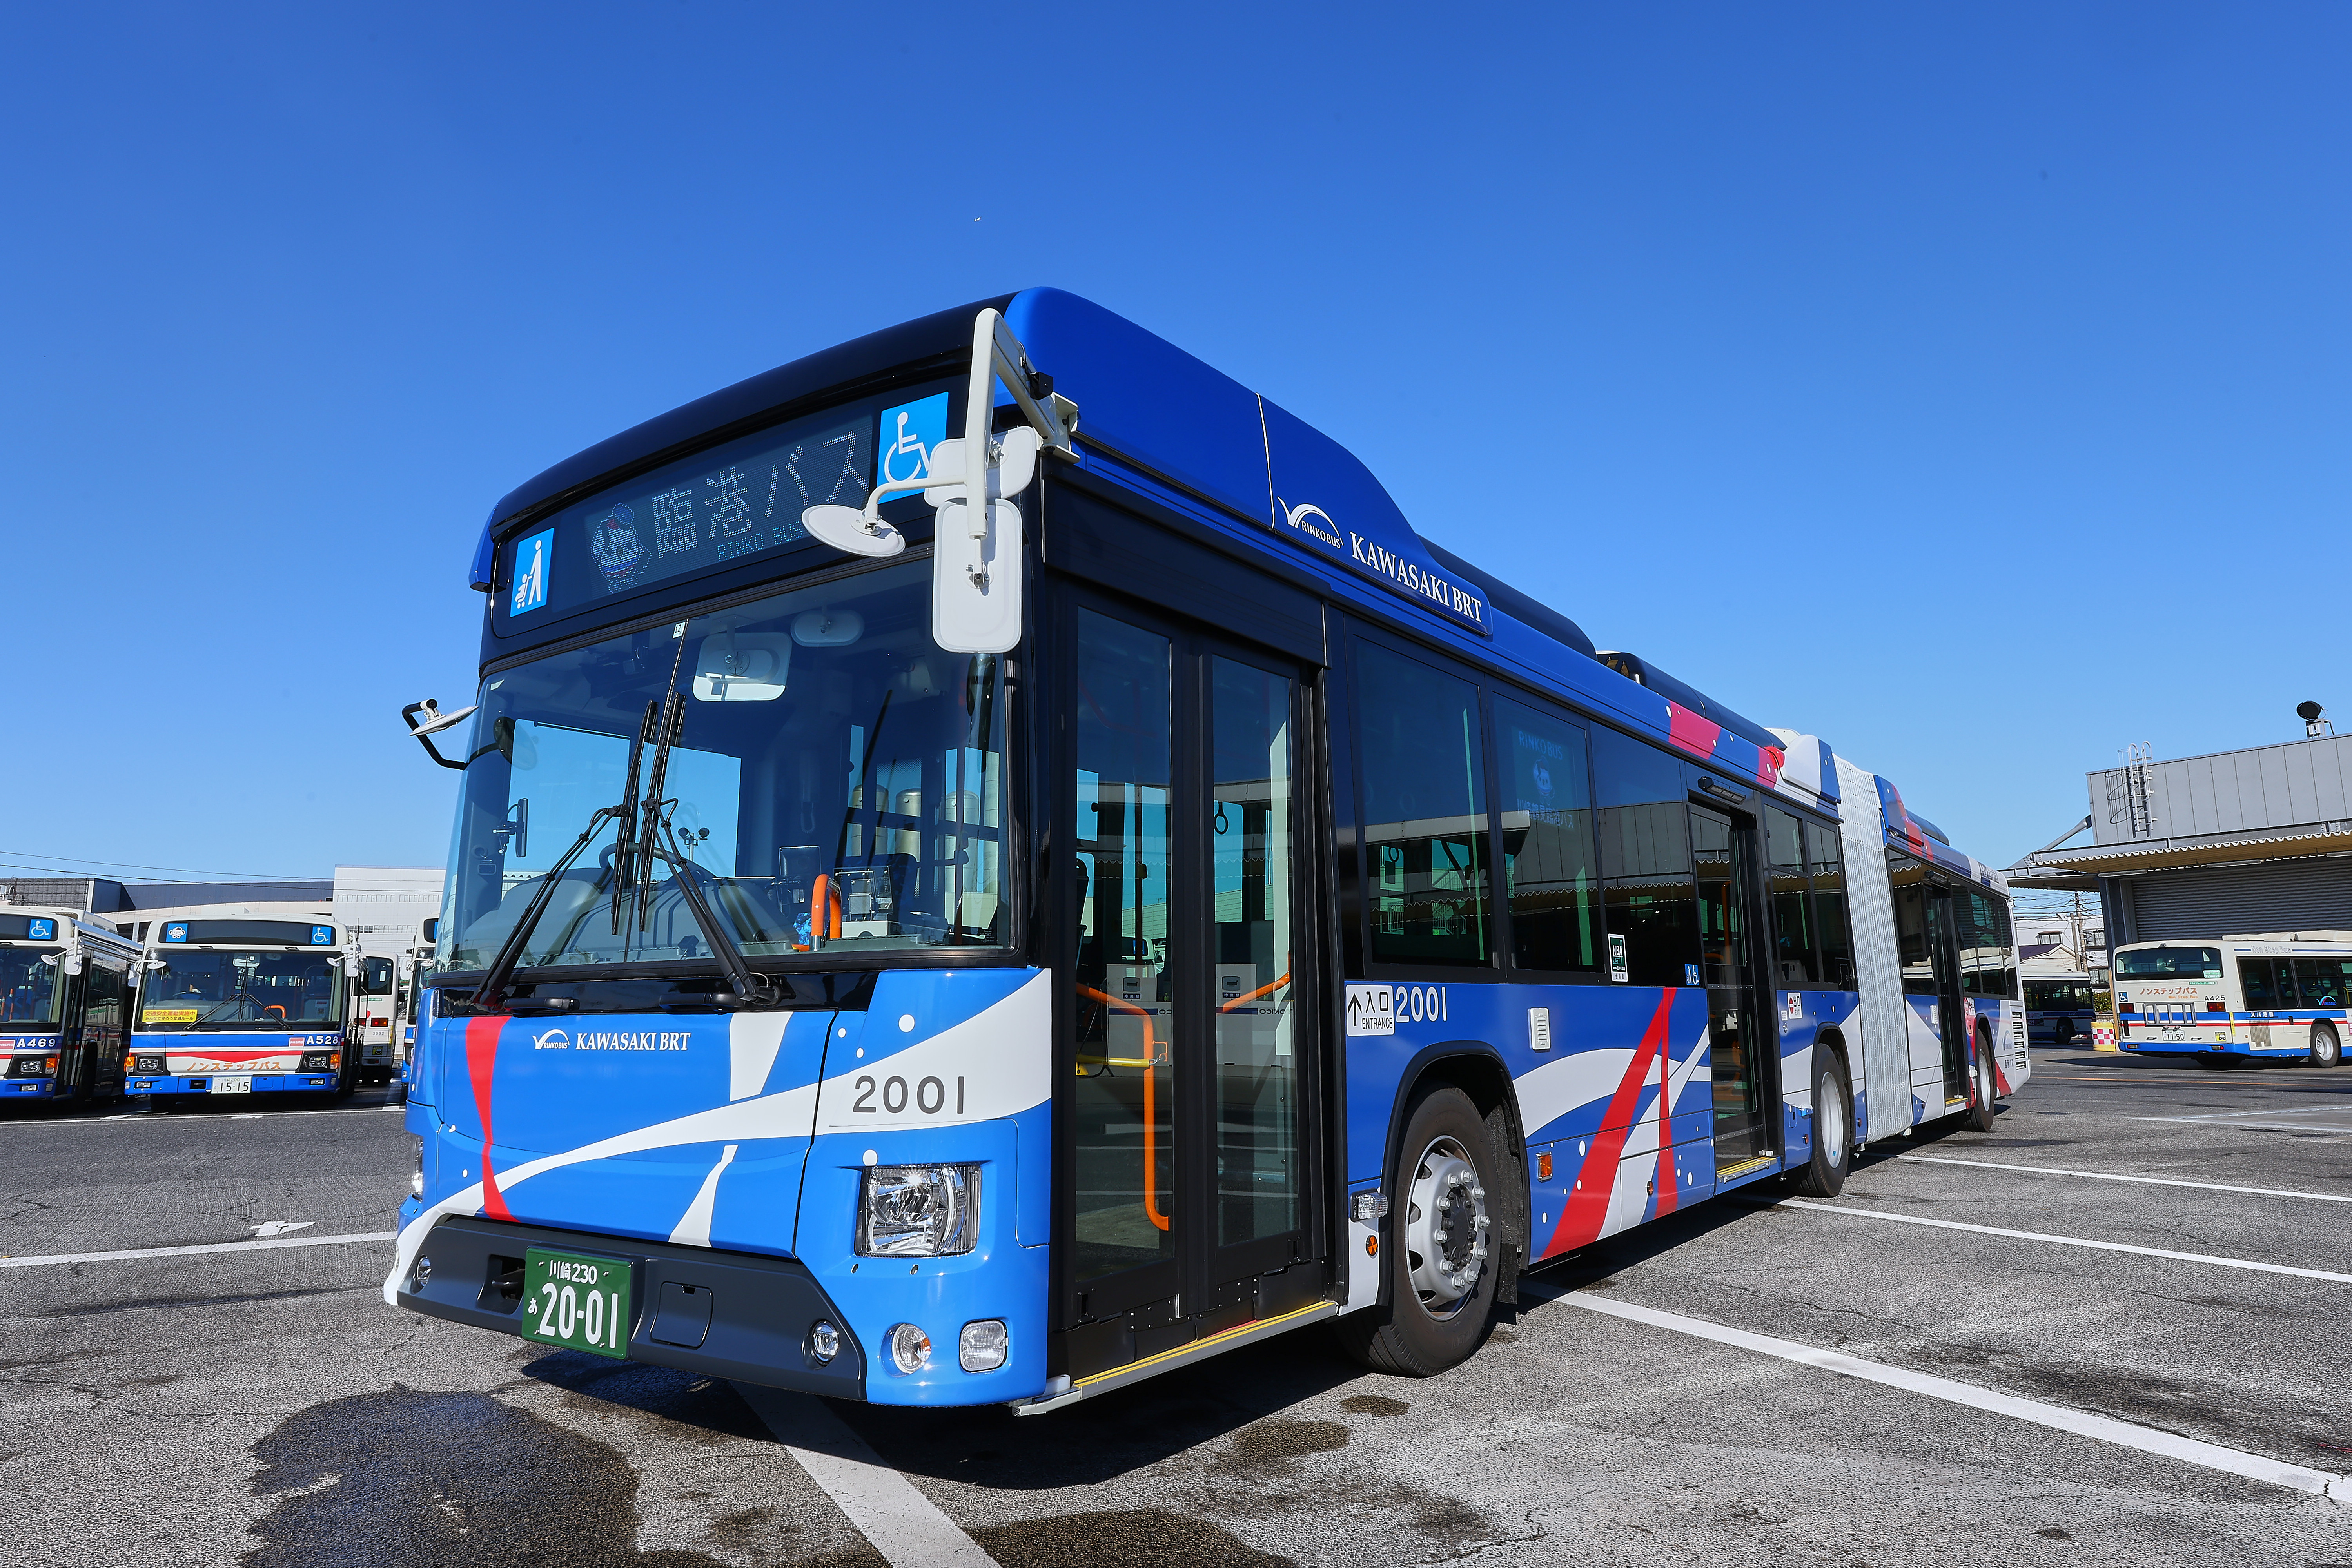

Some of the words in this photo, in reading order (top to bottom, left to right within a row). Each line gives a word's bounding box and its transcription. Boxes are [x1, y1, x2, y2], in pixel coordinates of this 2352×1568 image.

[652, 430, 869, 559] 臨港バス
[717, 533, 764, 562] RINKO
[772, 521, 804, 546] BUS
[1350, 531, 1450, 607] KAWASAKI
[1451, 585, 1482, 623] BRT
[675, 624, 681, 633] 12
[1518, 730, 1546, 755] RINKO
[1547, 741, 1563, 761] BUS
[1366, 991, 1388, 1014] 入口
[1395, 985, 1447, 1023] 2001
[1362, 1017, 1393, 1030] ENTRANCE
[16, 1038, 56, 1048] A469
[306, 1035, 338, 1045] A528
[575, 1033, 657, 1051] KAWASAKI
[659, 1032, 691, 1051] BRT
[187, 1060, 281, 1071] ノンステップバス
[220, 1082, 249, 1092] 15-15
[853, 1075, 965, 1114] 2001
[528, 1297, 538, 1315] あ
[539, 1282, 619, 1349] 20-01
